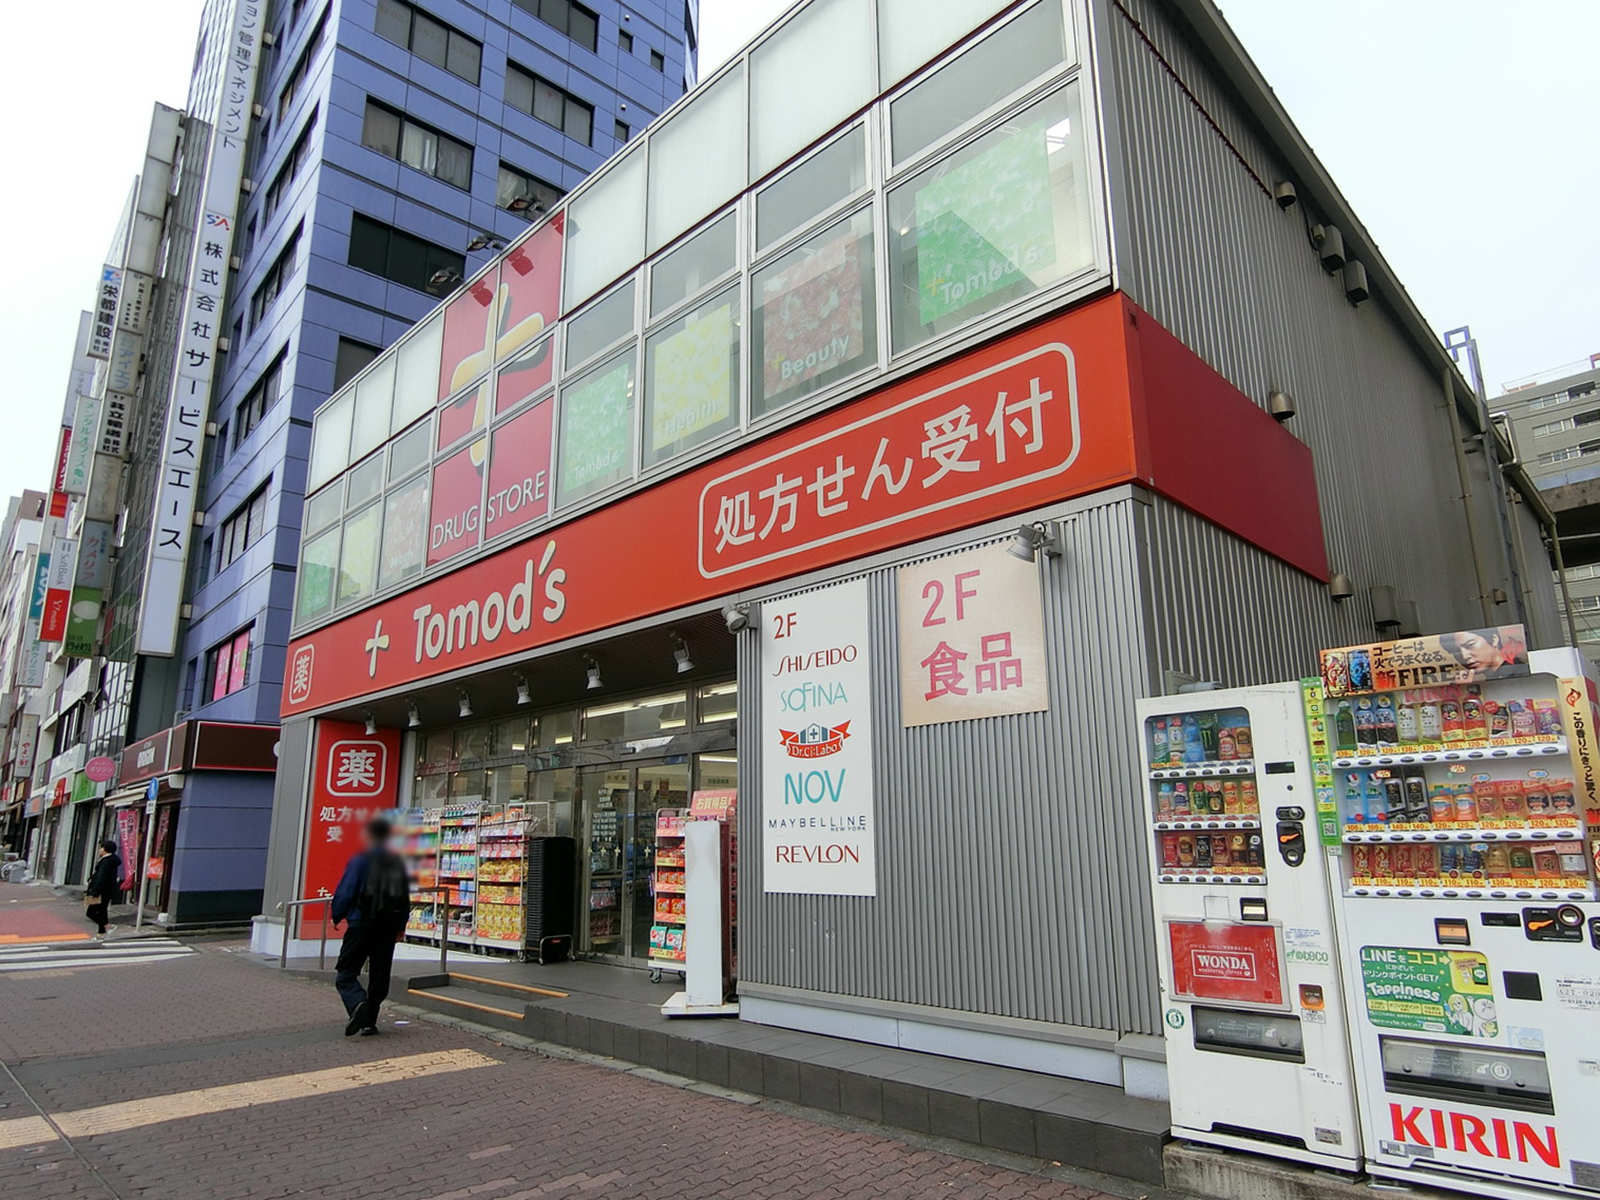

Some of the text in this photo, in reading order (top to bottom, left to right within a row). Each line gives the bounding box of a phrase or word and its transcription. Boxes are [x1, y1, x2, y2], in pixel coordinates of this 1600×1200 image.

[96, 284, 119, 340] 栄都建設
[781, 335, 851, 380] Beauty
[159, 240, 224, 550] 株式会社サービスエース
[665, 397, 718, 438] Health
[713, 377, 1054, 554] 処方せん受付
[432, 470, 546, 550] DRUG STORE
[57, 553, 71, 586] SoftBank
[413, 540, 567, 664] Tomod's
[921, 569, 982, 629] 2F
[773, 612, 798, 639] 2F
[772, 644, 858, 677] SHISEIDO
[920, 631, 1024, 702] 食品
[1373, 641, 1425, 656] コーヒーは
[1374, 651, 1447, 669] 火でうまくなる。
[293, 655, 311, 695] 薬
[780, 681, 848, 713] SOFINA
[336, 749, 376, 788] 薬
[784, 768, 847, 806] NOV
[768, 815, 867, 829] MAYBELLINE
[775, 844, 860, 864] REVLON
[1197, 954, 1250, 970] WONDA
[1366, 981, 1441, 1003] Tappiness
[1388, 1103, 1561, 1168] KIRIN
